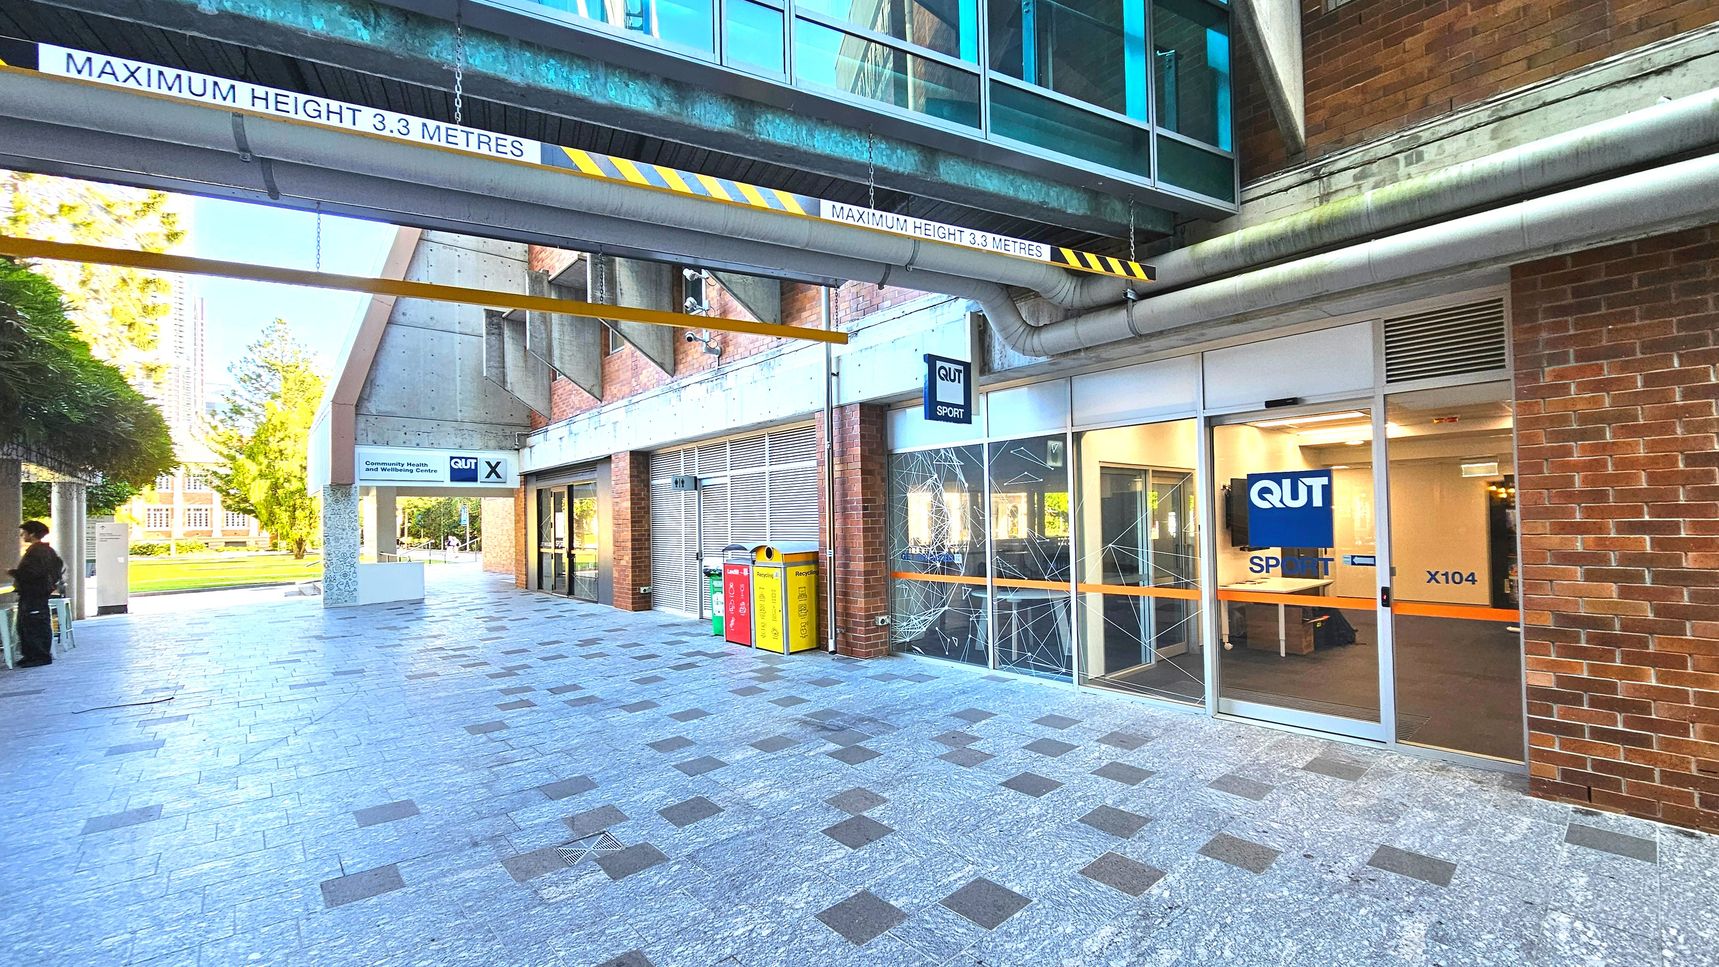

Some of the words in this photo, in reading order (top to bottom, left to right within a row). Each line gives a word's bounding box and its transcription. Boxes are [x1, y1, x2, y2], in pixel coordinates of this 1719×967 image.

[65, 52, 236, 104] MAXIMUM
[251, 87, 362, 131] HEIGHT
[372, 112, 410, 137] 3.3
[421, 121, 525, 158] METRES
[831, 204, 908, 232] MAXIMUM
[913, 220, 965, 244] HEIGHT
[969, 232, 988, 248] 3.3
[992, 237, 1042, 258] METRES
[937, 365, 963, 385] QUT
[936, 405, 964, 419] SPORT
[365, 460, 405, 468] Community
[450, 458, 477, 470] QUT
[484, 460, 503, 479] X
[1249, 476, 1329, 509] QUT
[1249, 555, 1334, 576] SPORT
[756, 571, 774, 580] Recycling
[1425, 569, 1478, 586] X104
